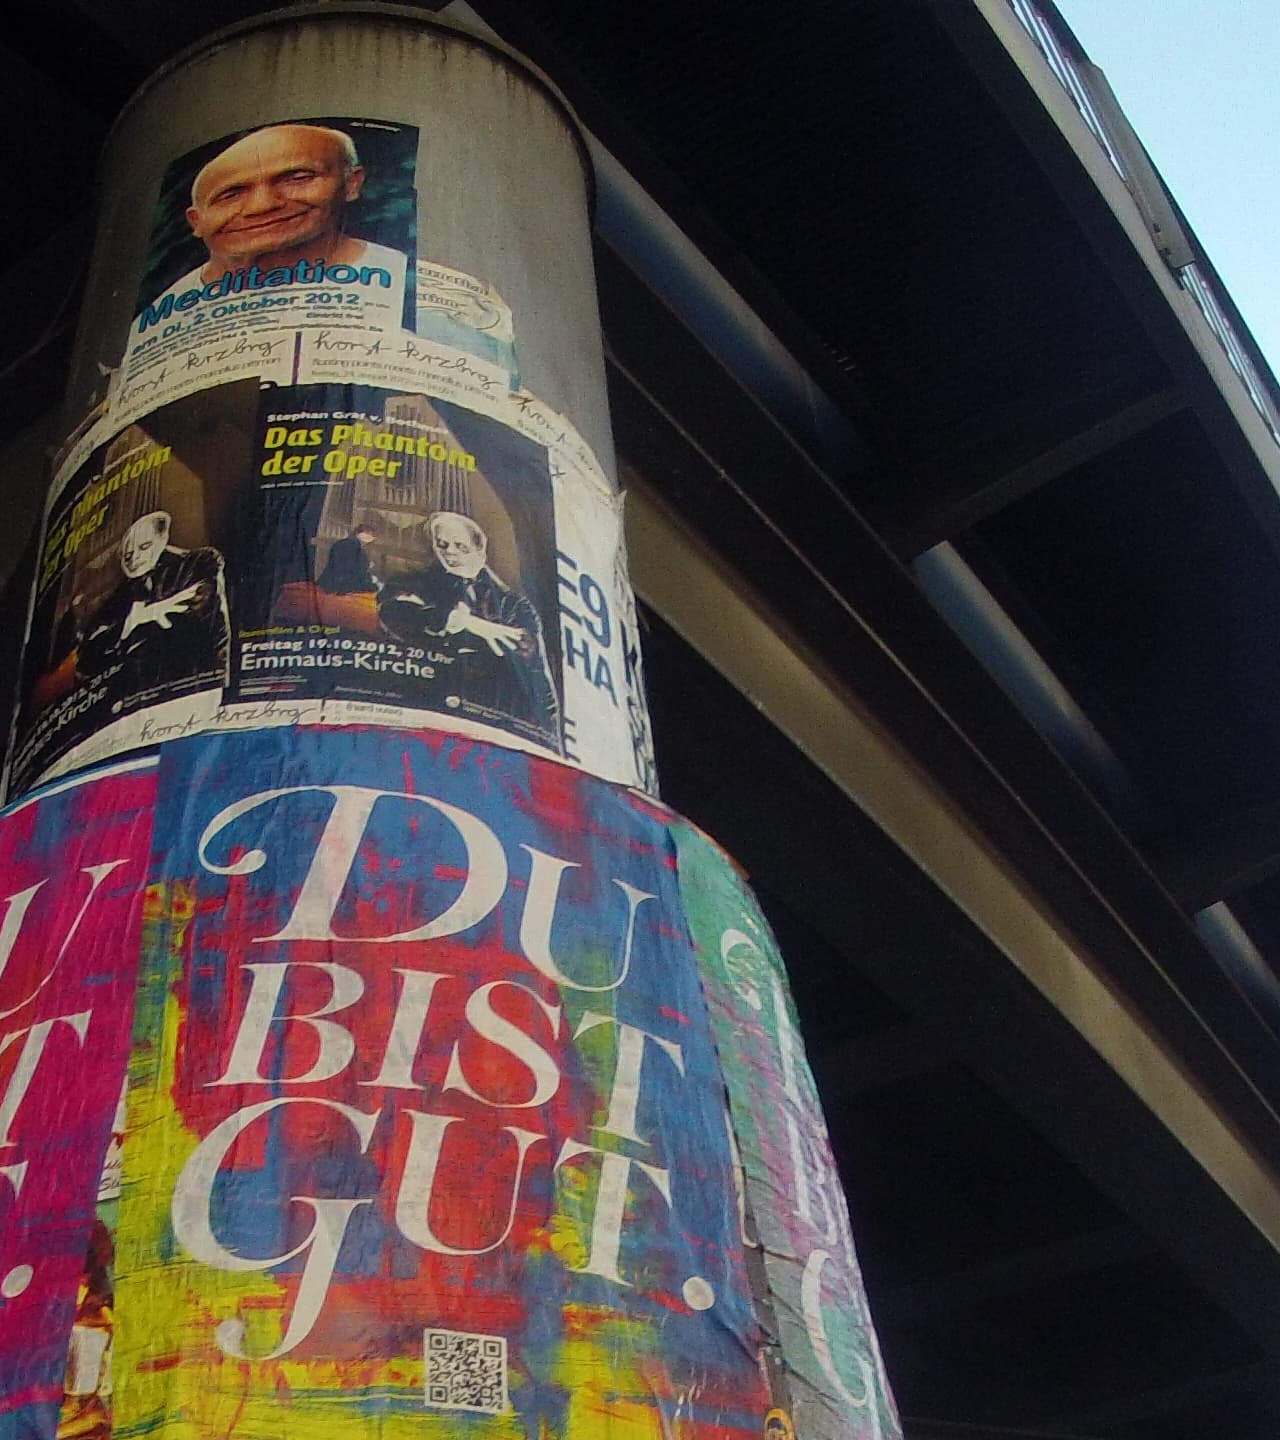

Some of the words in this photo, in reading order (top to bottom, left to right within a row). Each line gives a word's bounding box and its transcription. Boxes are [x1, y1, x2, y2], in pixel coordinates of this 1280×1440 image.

[137, 257, 392, 334] Meditation
[131, 335, 158, 356] am
[211, 296, 302, 319] Oktober
[304, 293, 360, 306] 2012
[266, 411, 329, 423] Stephan
[260, 449, 315, 478] der
[322, 448, 402, 480] Oper
[263, 424, 323, 449] Das
[329, 422, 478, 473] Phantom
[239, 651, 436, 681] Emmaus-Kirche
[241, 638, 303, 653] Freitag
[308, 637, 403, 658] 19.10.2012,
[406, 645, 425, 660] 20
[427, 649, 456, 666] Uhr
[198, 784, 660, 992] DU
[202, 961, 687, 1150] BIST
[170, 1096, 717, 1362] GUT.
